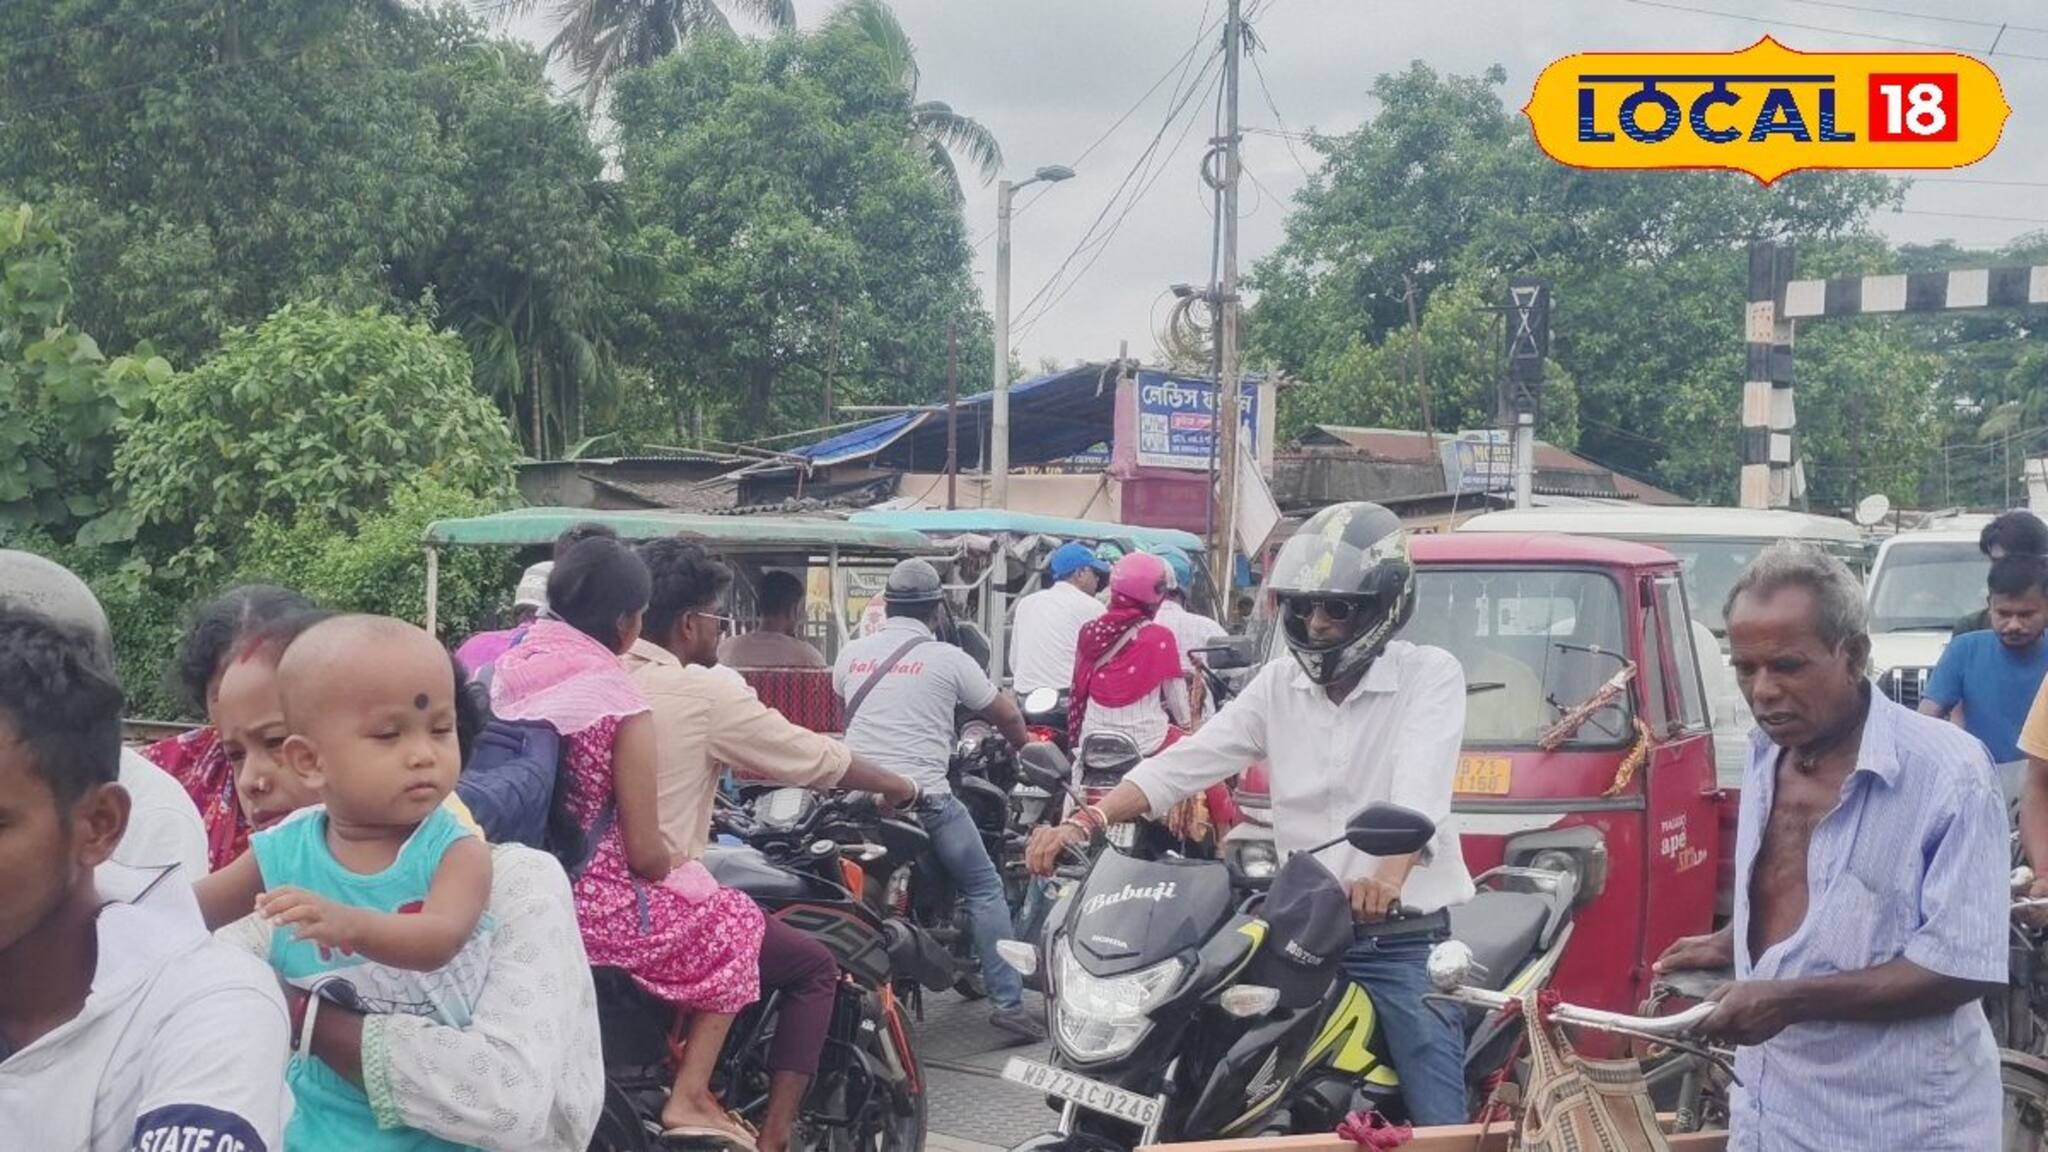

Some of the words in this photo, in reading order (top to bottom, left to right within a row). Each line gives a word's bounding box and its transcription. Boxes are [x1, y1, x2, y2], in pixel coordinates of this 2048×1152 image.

[1141, 381, 1199, 409] লেডিস
[1082, 881, 1177, 916] Babuji
[140, 1126, 215, 1152] STATE
